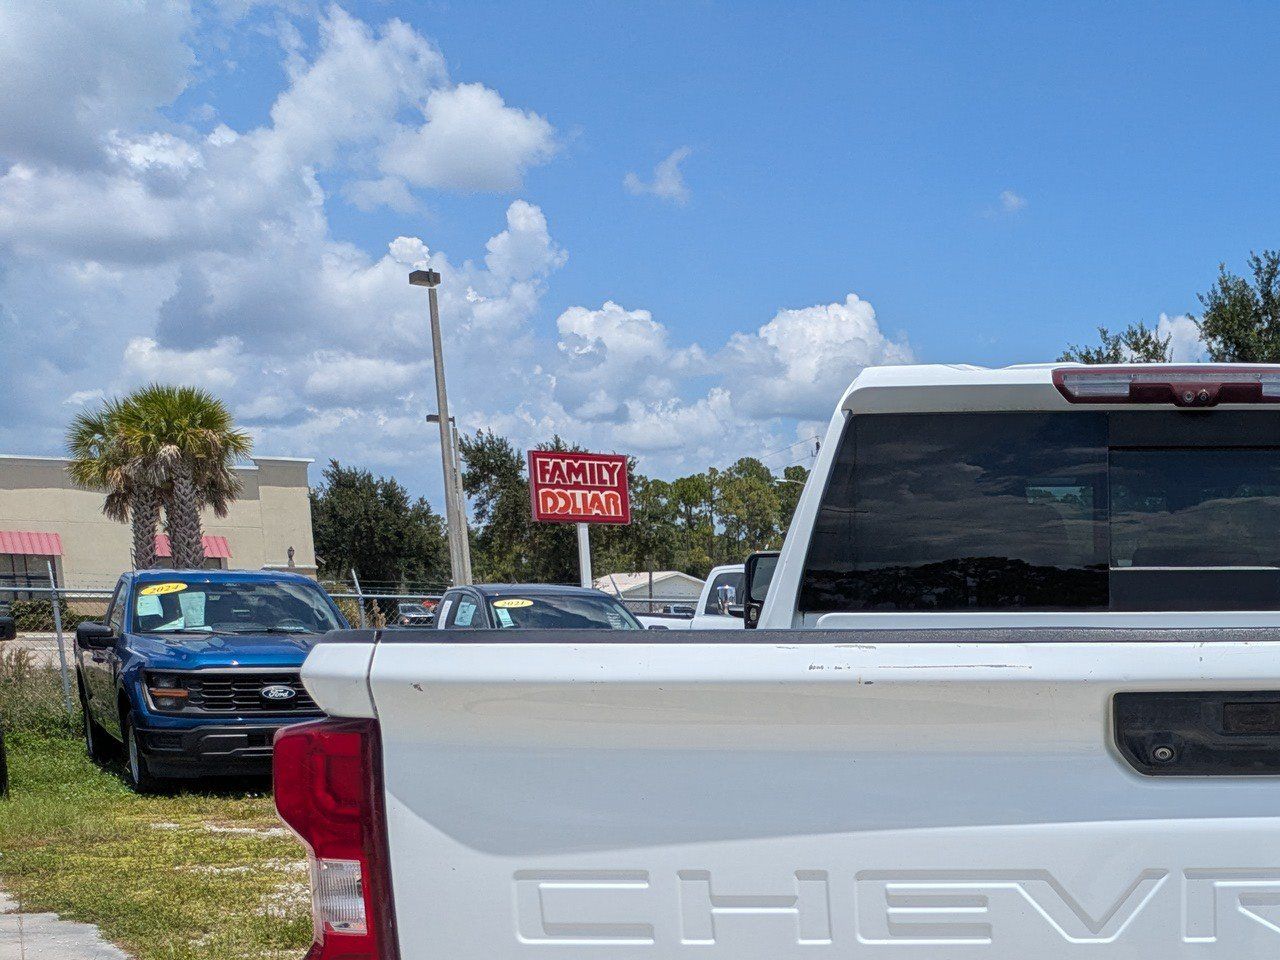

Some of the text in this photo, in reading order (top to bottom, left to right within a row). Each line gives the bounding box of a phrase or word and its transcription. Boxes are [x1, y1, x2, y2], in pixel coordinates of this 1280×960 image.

[537, 458, 622, 487] FAMILY
[539, 488, 622, 516] DOLLAR
[268, 687, 290, 698] Ford
